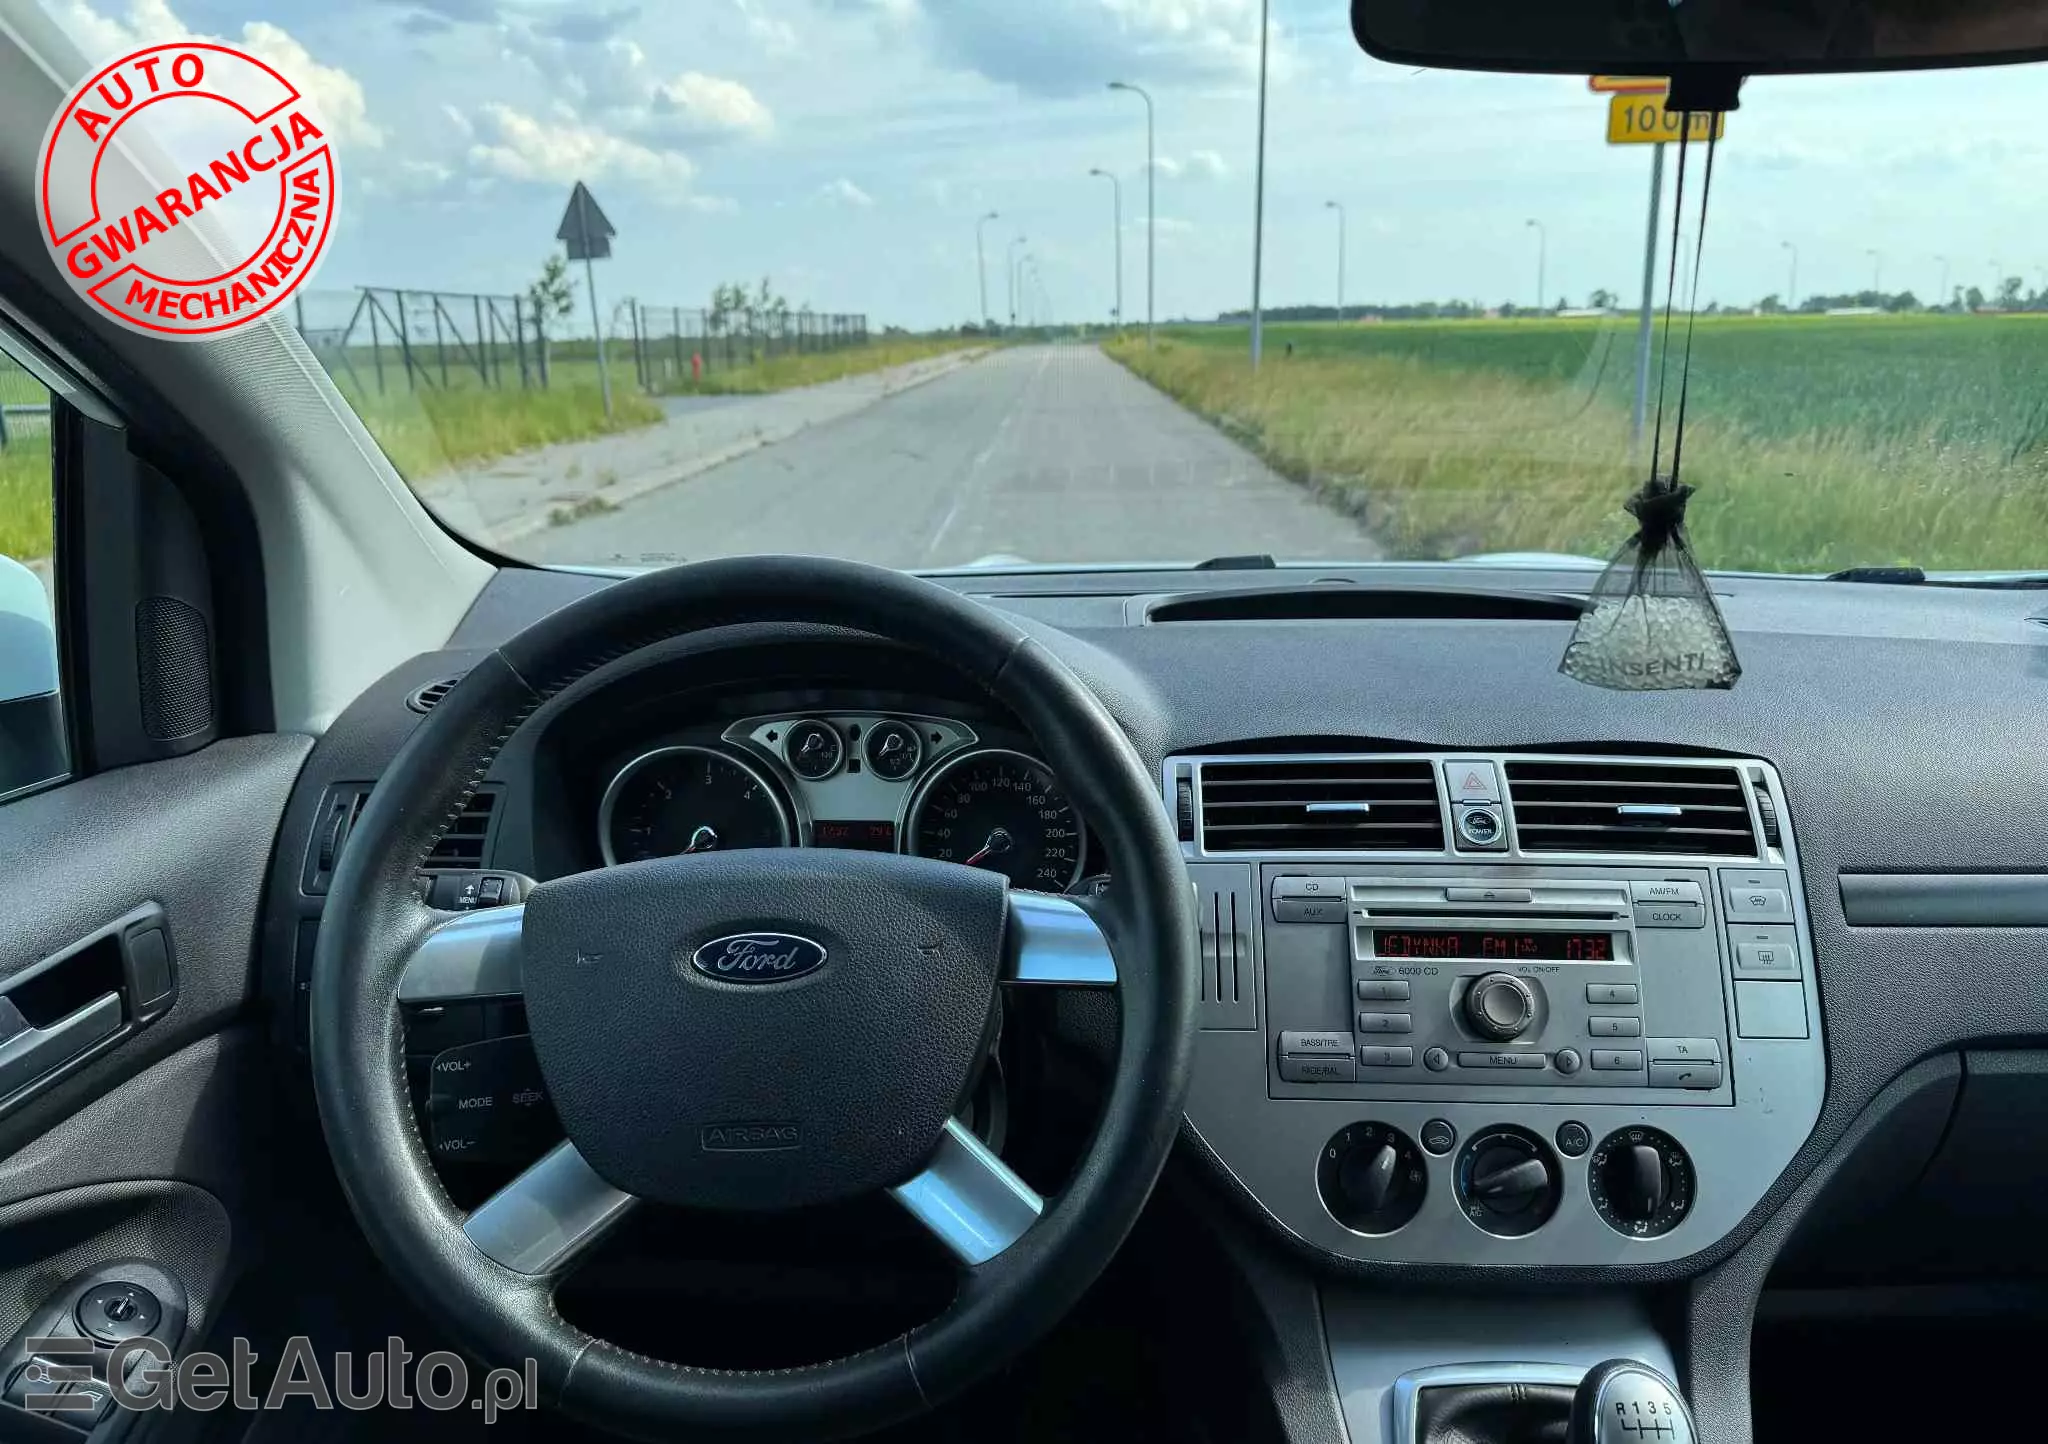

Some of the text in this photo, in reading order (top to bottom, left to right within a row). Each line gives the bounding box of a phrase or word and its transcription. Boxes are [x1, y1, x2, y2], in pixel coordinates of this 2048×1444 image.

[1624, 104, 1681, 133] 100
[1601, 652, 1705, 677] INSENTI
[705, 775, 712, 785] 3
[991, 777, 1010, 788] 120
[969, 782, 988, 792] 100
[1013, 782, 1032, 792] 140
[665, 790, 672, 800] 2
[743, 791, 750, 800] 4
[957, 793, 971, 804] 80
[1027, 795, 1046, 805] 160
[944, 808, 958, 819] 60
[1039, 809, 1057, 820] 180
[937, 828, 950, 838] 40
[1045, 828, 1065, 838] 200
[939, 849, 952, 858] 20
[1045, 848, 1065, 858] 220
[1038, 868, 1057, 878] 240
[1305, 883, 1319, 891] CD
[1652, 912, 1682, 921] CLOCK
[717, 939, 799, 971] Ford
[1424, 966, 1439, 976] CD
[1677, 1044, 1689, 1054] TA
[1489, 1055, 1519, 1065] MENU
[458, 1096, 493, 1109] MODE
[512, 1091, 544, 1104] SEEK
[708, 1126, 799, 1142] AIRBAG
[1565, 1138, 1584, 1148] A/C
[1615, 1401, 1673, 1416] R 1 3 5
